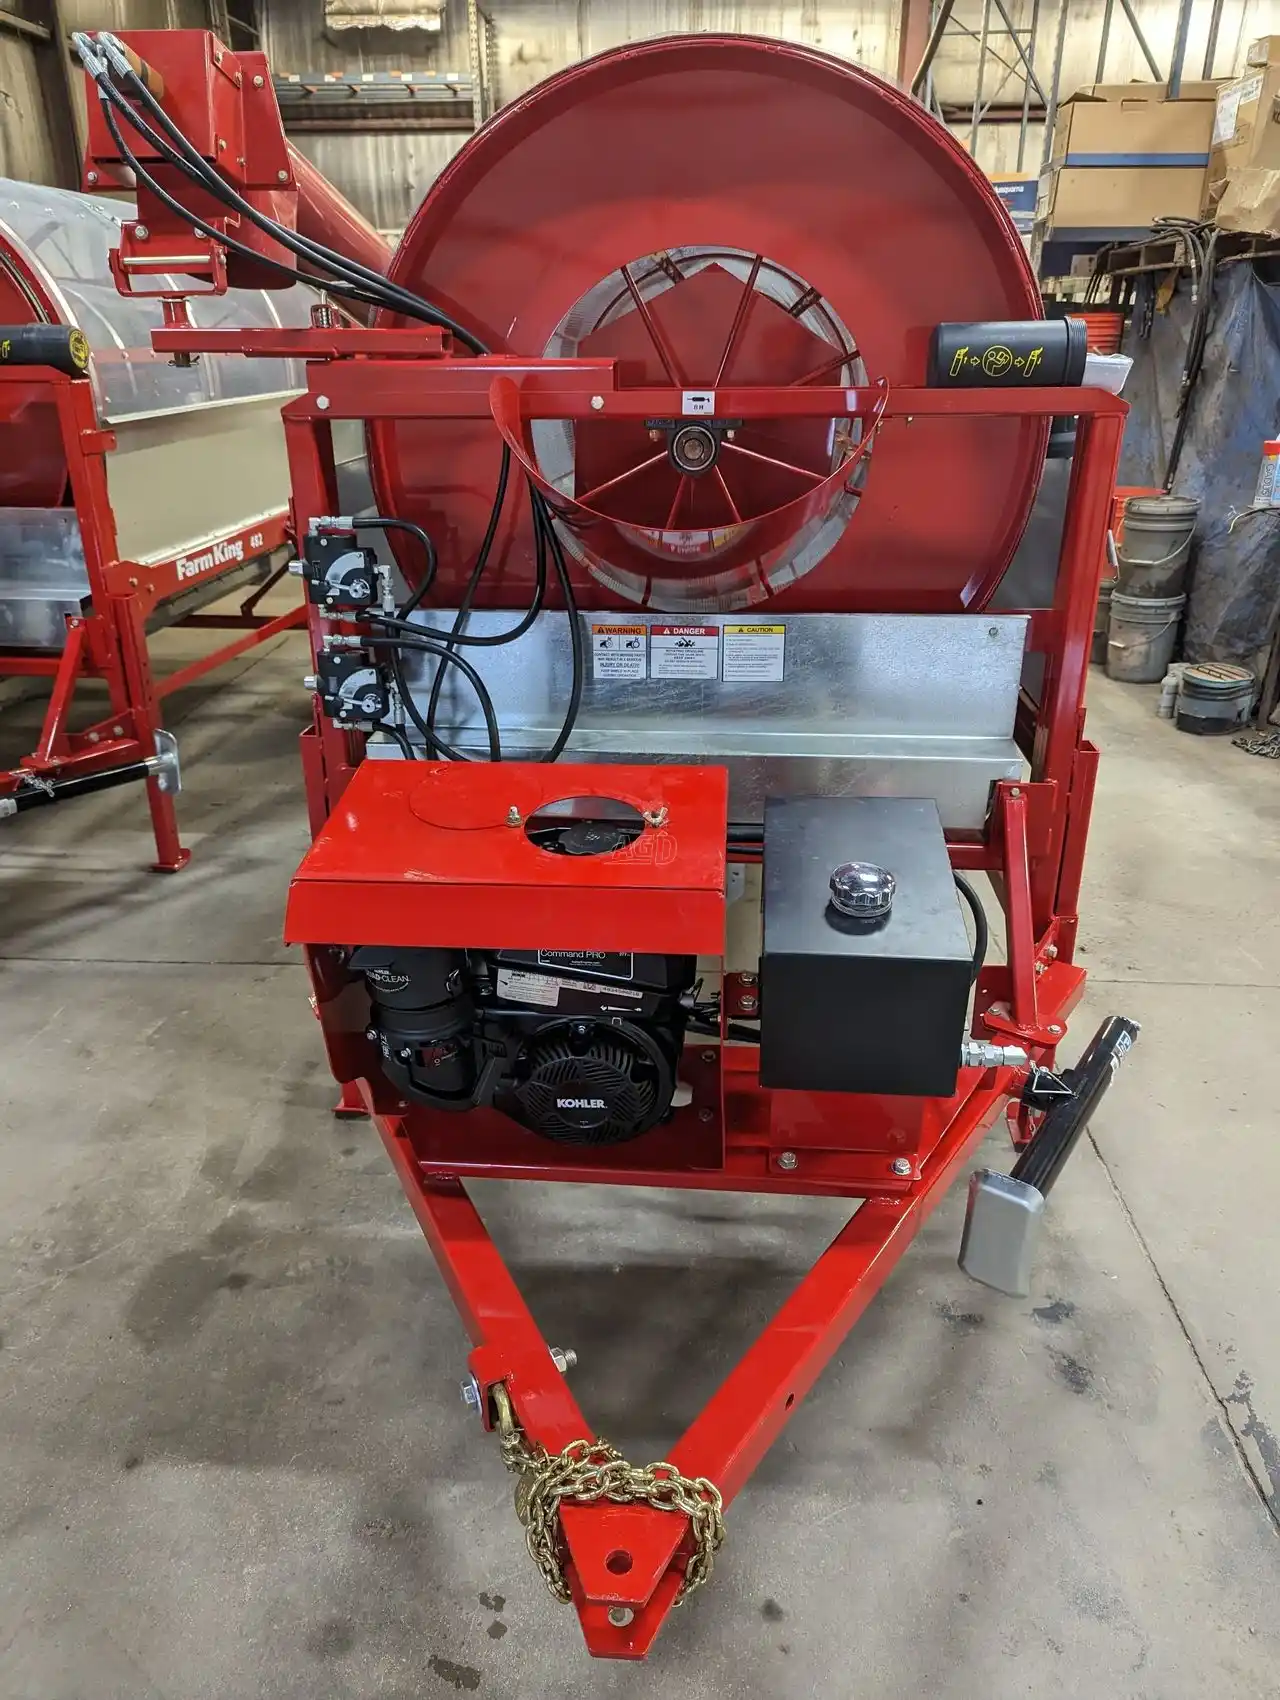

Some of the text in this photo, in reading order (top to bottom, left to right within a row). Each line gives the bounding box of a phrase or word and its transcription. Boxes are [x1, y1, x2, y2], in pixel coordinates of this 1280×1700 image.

[605, 627, 642, 635] WARNING
[673, 627, 706, 635] DANGER
[540, 949, 584, 958] Command
[556, 1098, 605, 1109] KOHLER
